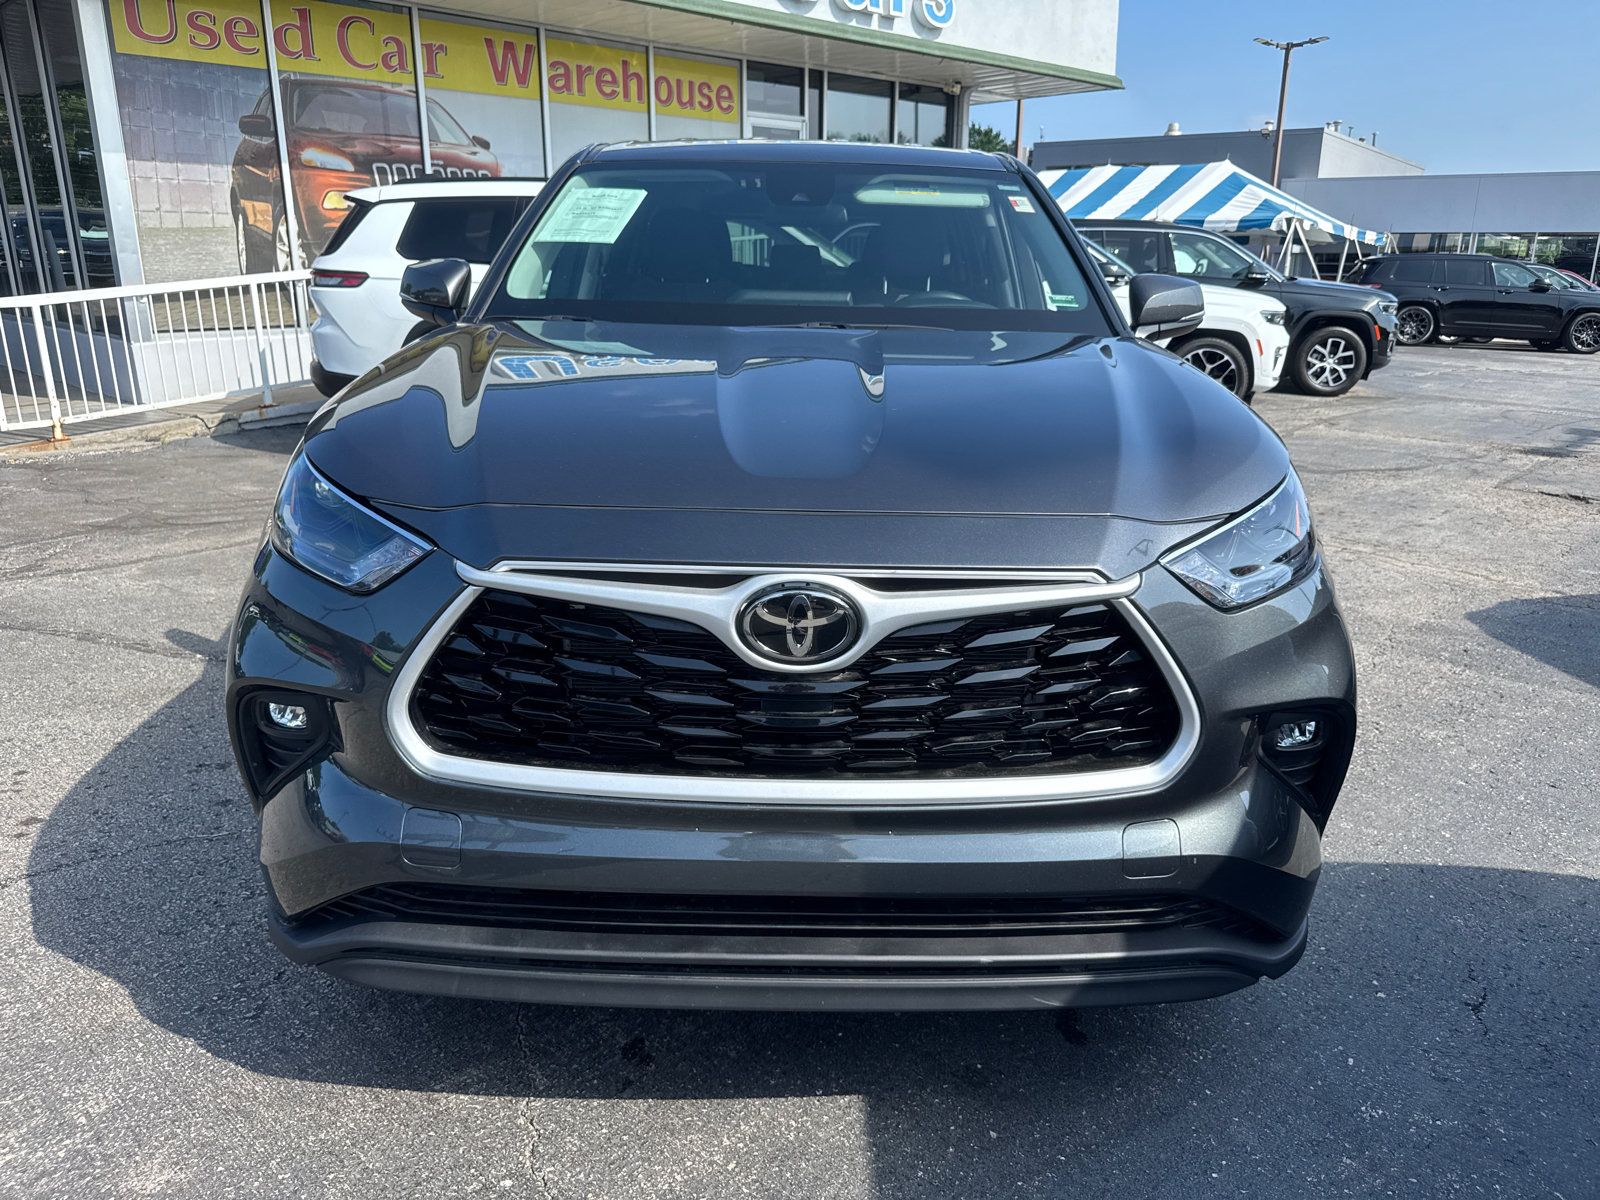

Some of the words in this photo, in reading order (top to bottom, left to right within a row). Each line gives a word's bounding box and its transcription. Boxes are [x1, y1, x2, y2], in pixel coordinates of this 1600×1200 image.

[122, 0, 319, 61] Used
[336, 15, 448, 78] Car
[484, 37, 735, 114] Warehouse
